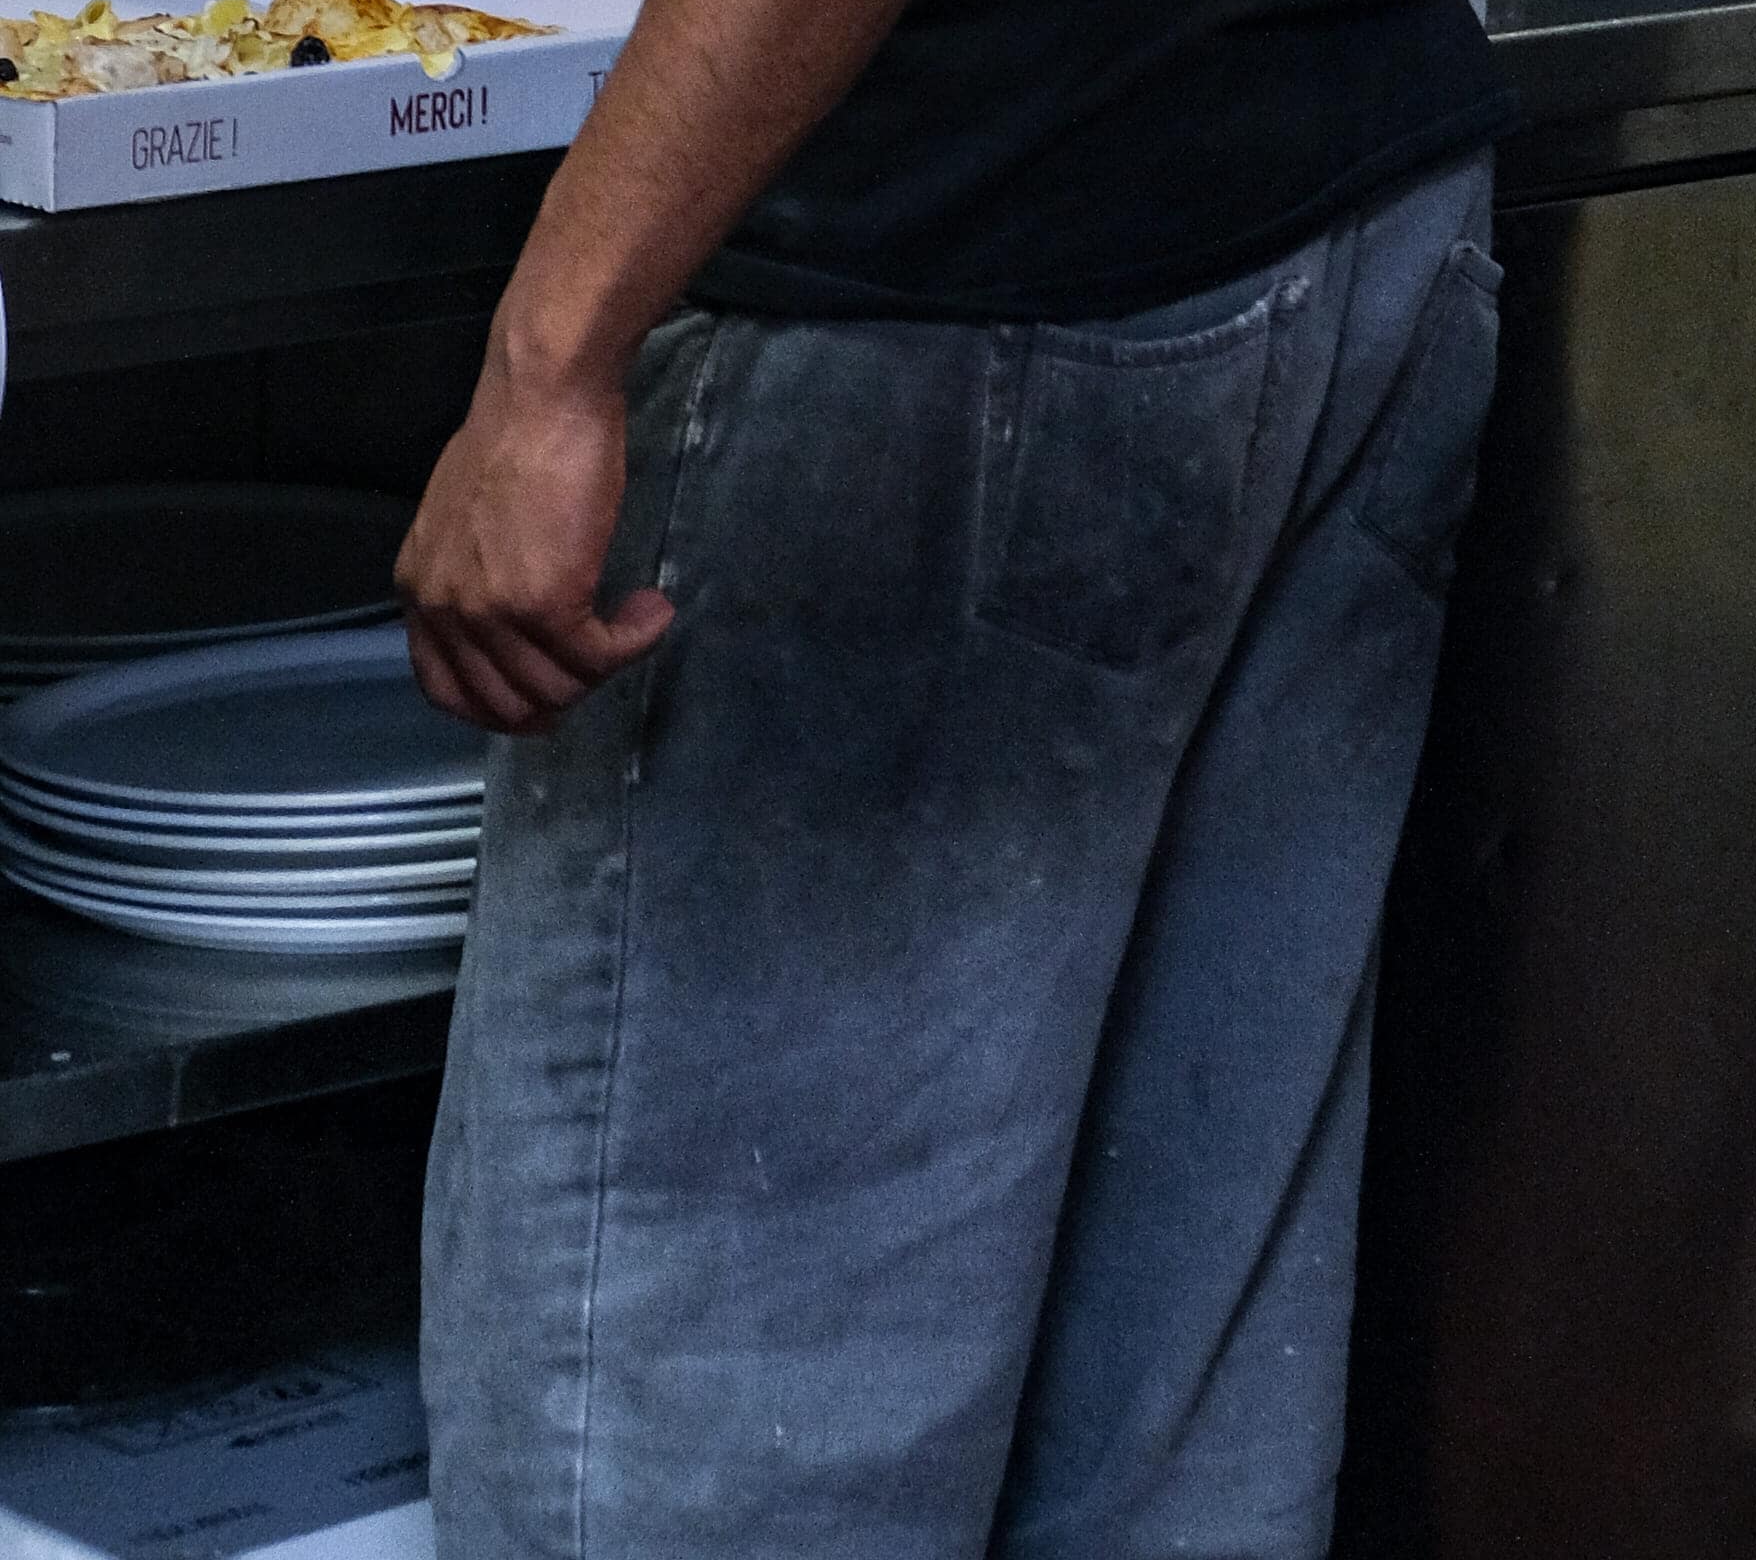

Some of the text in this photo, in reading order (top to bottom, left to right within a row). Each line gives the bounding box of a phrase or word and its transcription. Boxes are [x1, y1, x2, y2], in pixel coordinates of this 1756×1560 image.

[390, 86, 488, 136] MERCI !
[131, 118, 239, 171] GRAZIE !
